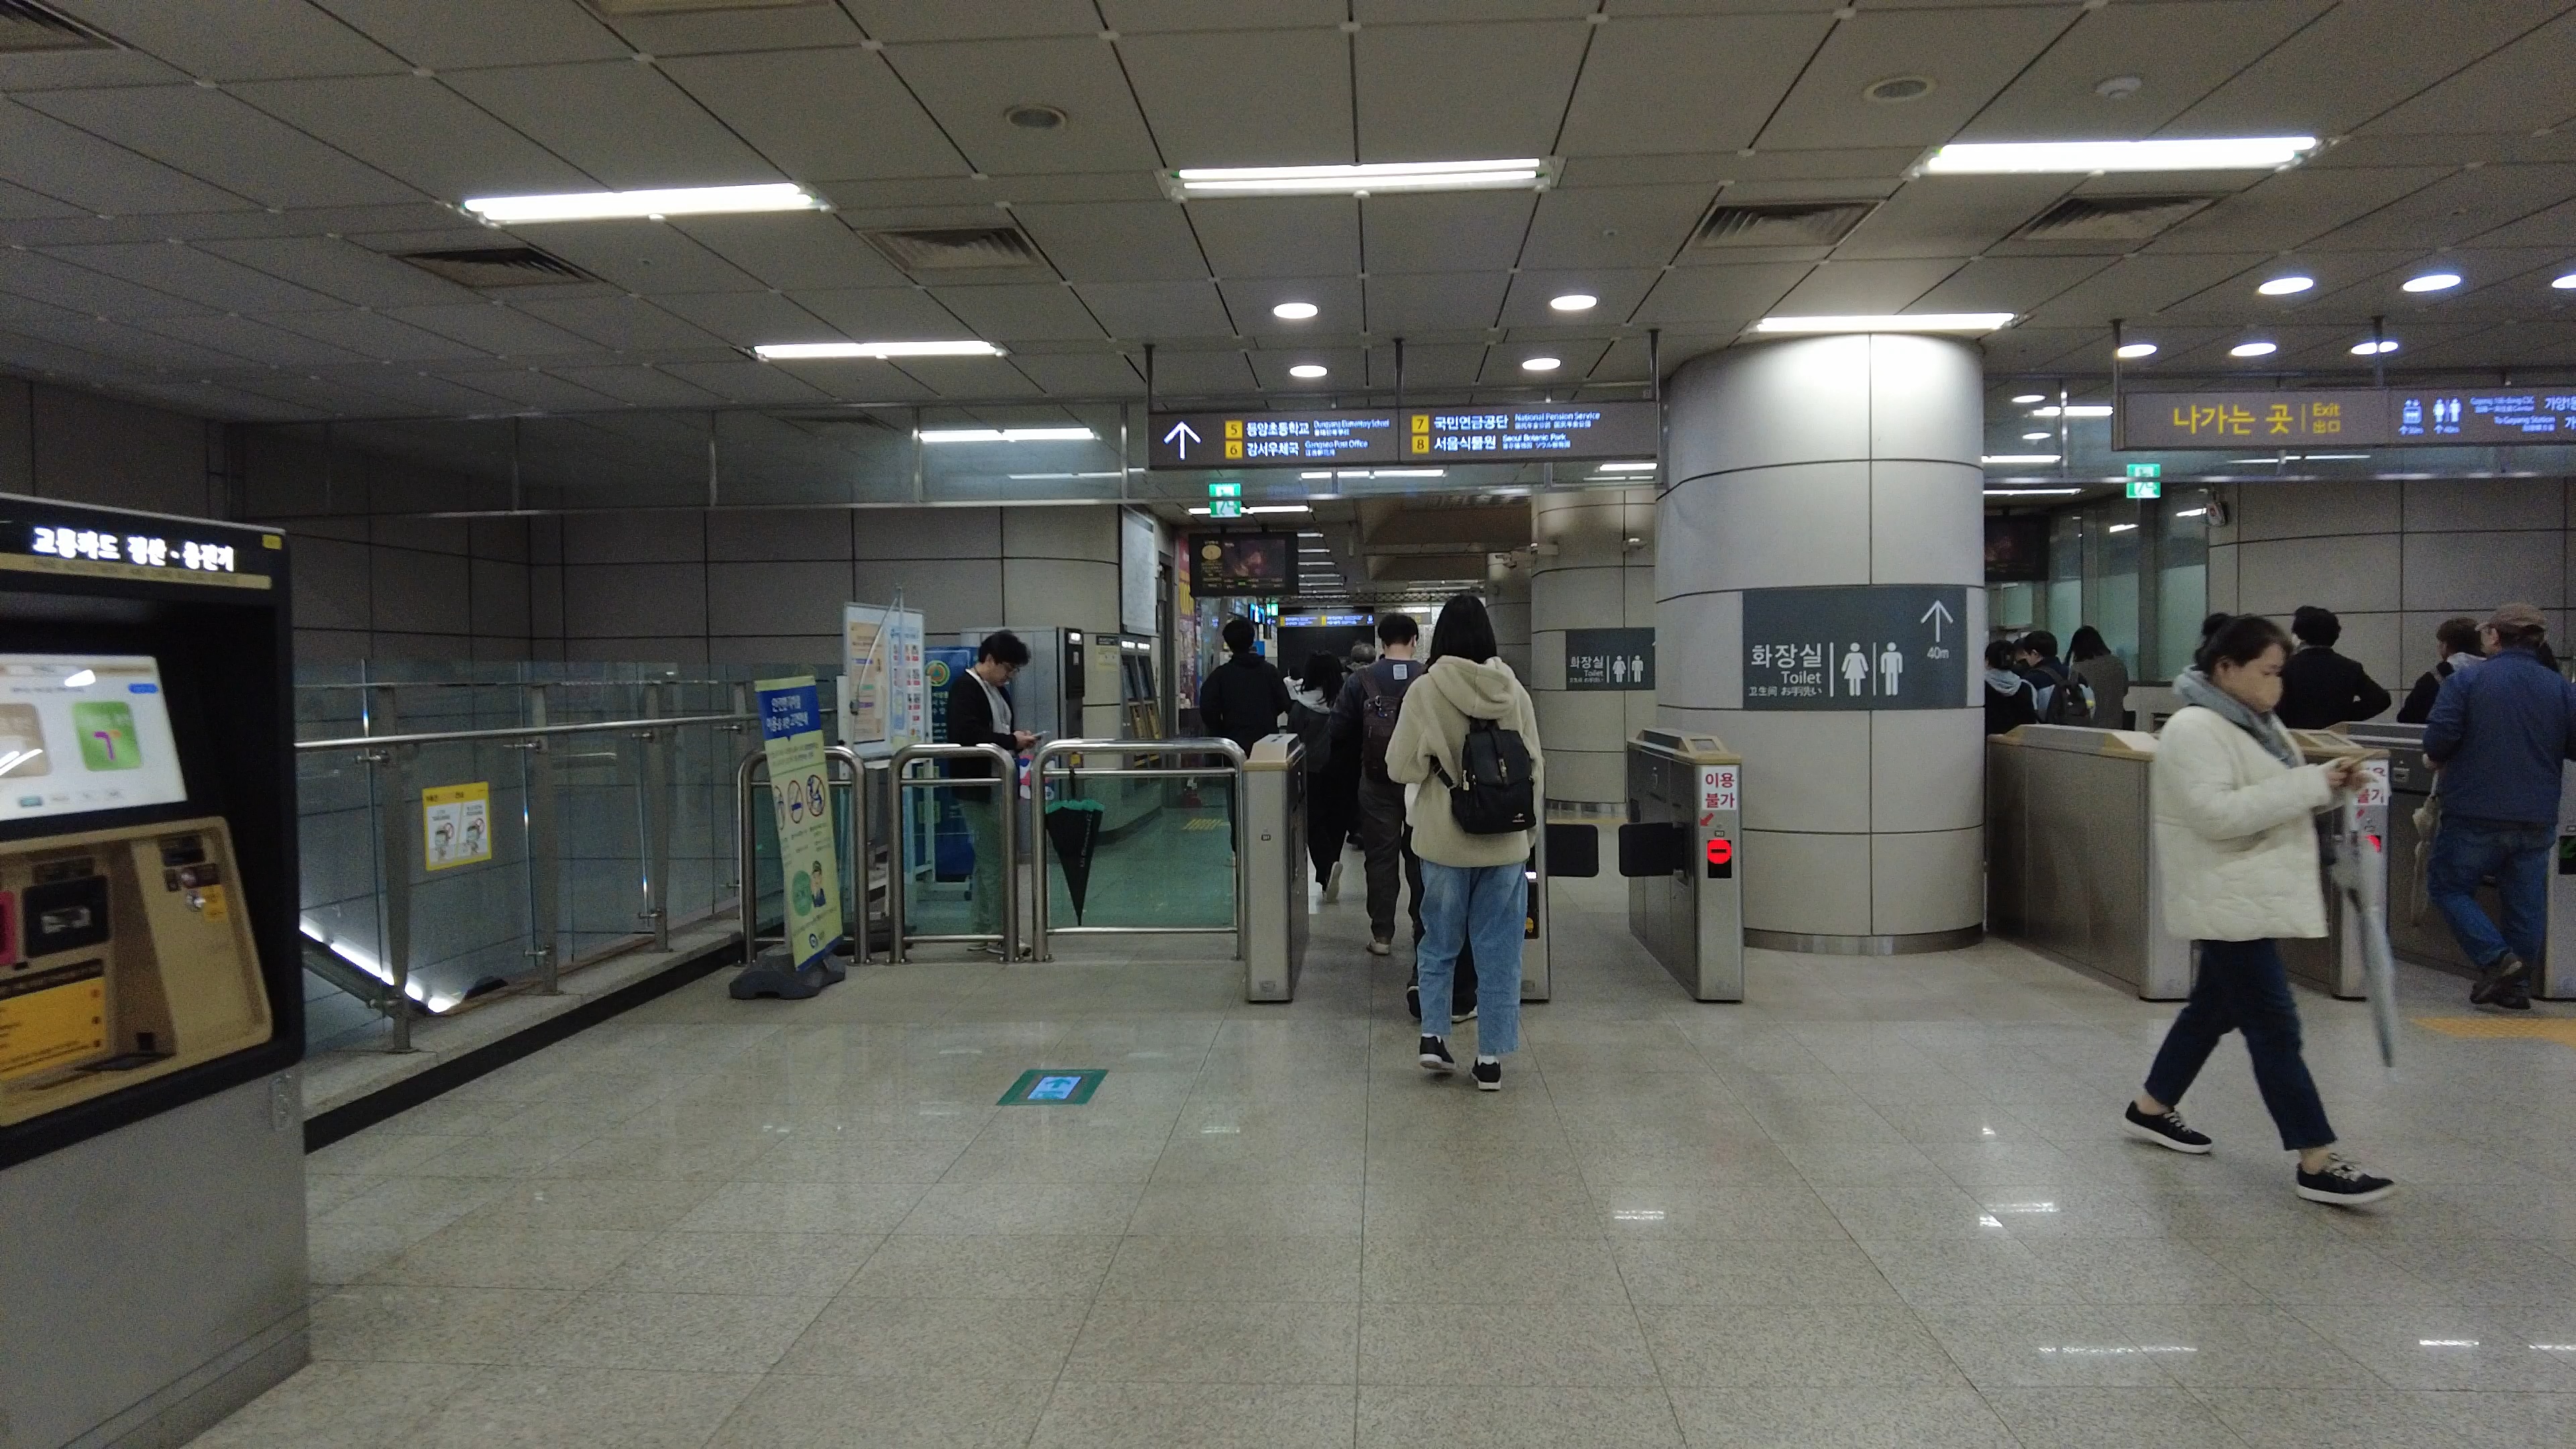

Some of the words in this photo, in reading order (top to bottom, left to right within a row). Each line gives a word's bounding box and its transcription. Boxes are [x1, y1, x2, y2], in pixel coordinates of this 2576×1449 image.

[2313, 402, 2341, 417] Exit
[1416, 419, 1424, 429] 7
[2174, 404, 2256, 435] 나가는
[2265, 404, 2294, 434] 곳
[1230, 424, 1238, 436] 5
[2313, 420, 2341, 434] 出口
[1230, 443, 1238, 455] 6
[1348, 439, 1368, 447] Office
[1417, 439, 1425, 449] 8
[1751, 643, 1822, 668] 화장실
[1926, 647, 1949, 659] 40m
[1569, 655, 1603, 669] 화장실
[1780, 671, 1822, 684] Toilet
[1705, 772, 1735, 788] 이용
[1705, 792, 1735, 808] 불가
